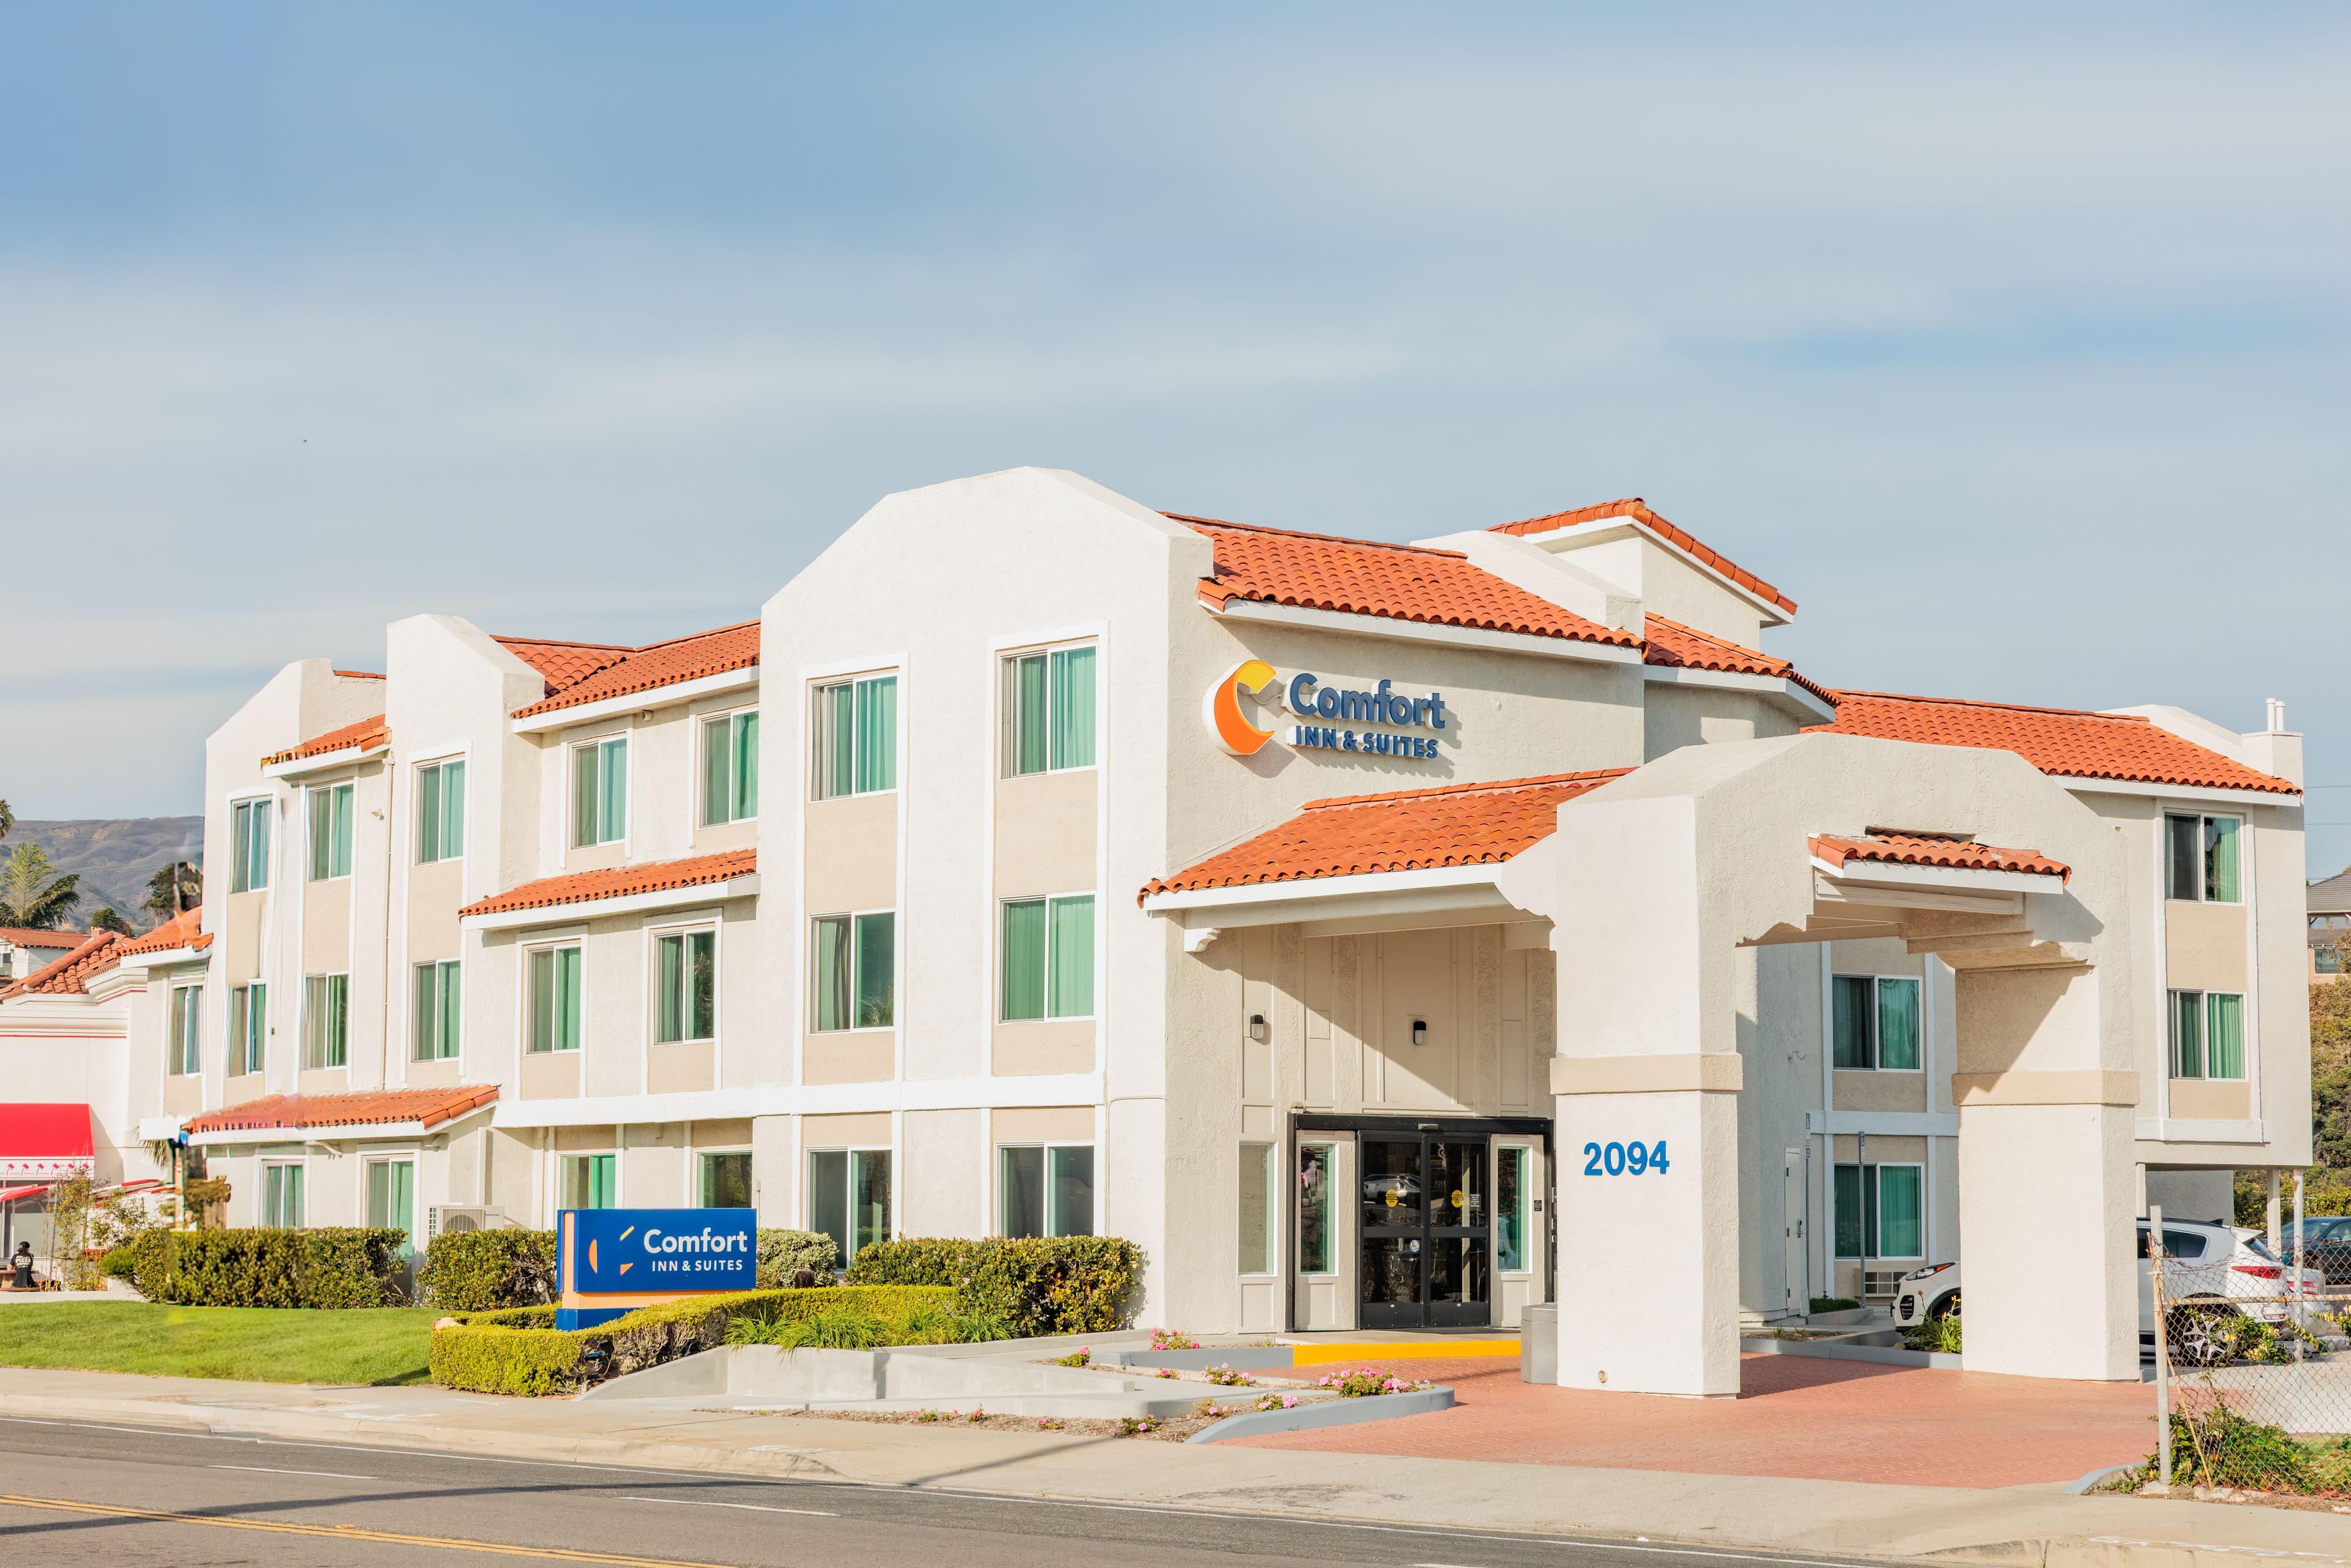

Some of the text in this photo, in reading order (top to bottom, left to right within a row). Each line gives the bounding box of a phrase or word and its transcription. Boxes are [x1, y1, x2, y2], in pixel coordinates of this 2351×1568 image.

[1289, 673, 1445, 729] Comfort
[1295, 725, 1438, 759] INN & SUITES
[1583, 1140, 1670, 1176] 2094
[643, 1227, 748, 1254] Comfort
[651, 1259, 743, 1272] INN & SUITES
